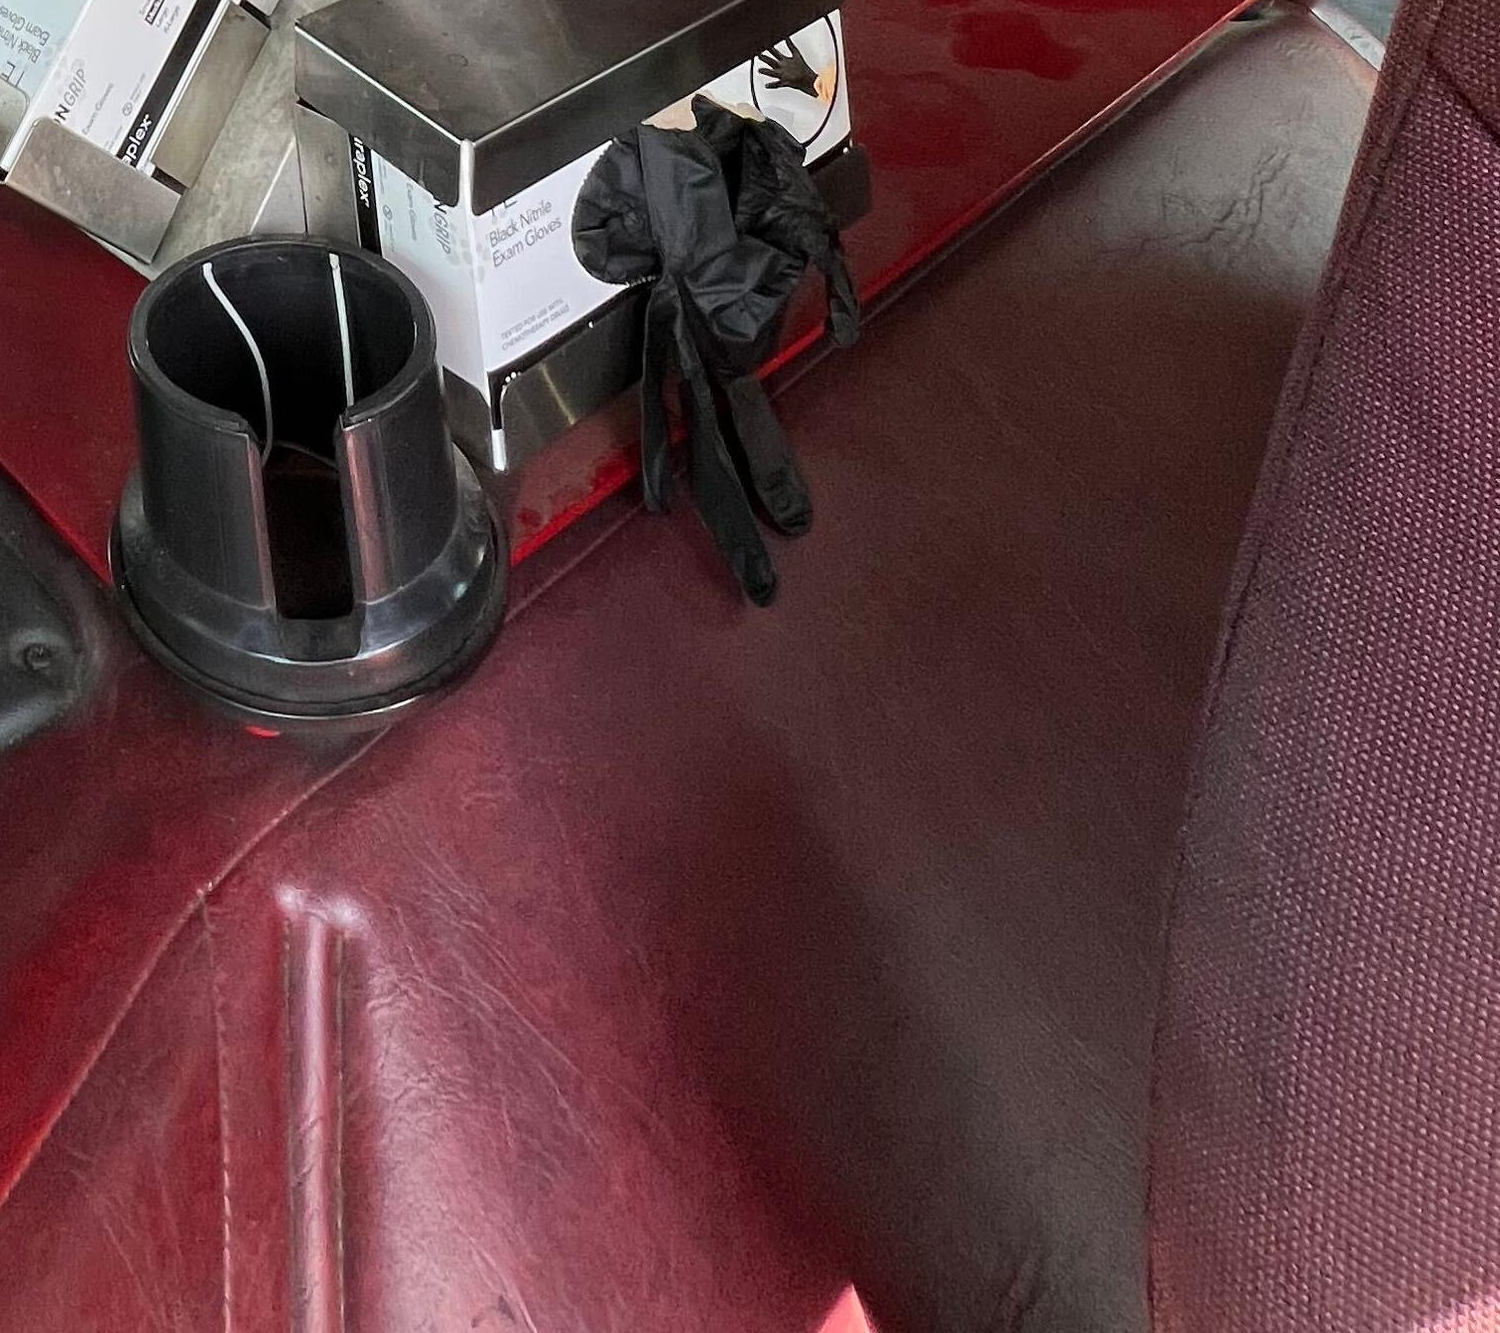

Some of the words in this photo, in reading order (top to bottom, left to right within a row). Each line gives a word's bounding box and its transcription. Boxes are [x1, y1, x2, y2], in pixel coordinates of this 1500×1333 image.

[25, 23, 50, 46] Exam
[489, 218, 517, 248] Black
[520, 200, 552, 228] Nitrile
[492, 241, 524, 268] Exam
[525, 217, 562, 247] Gloves
